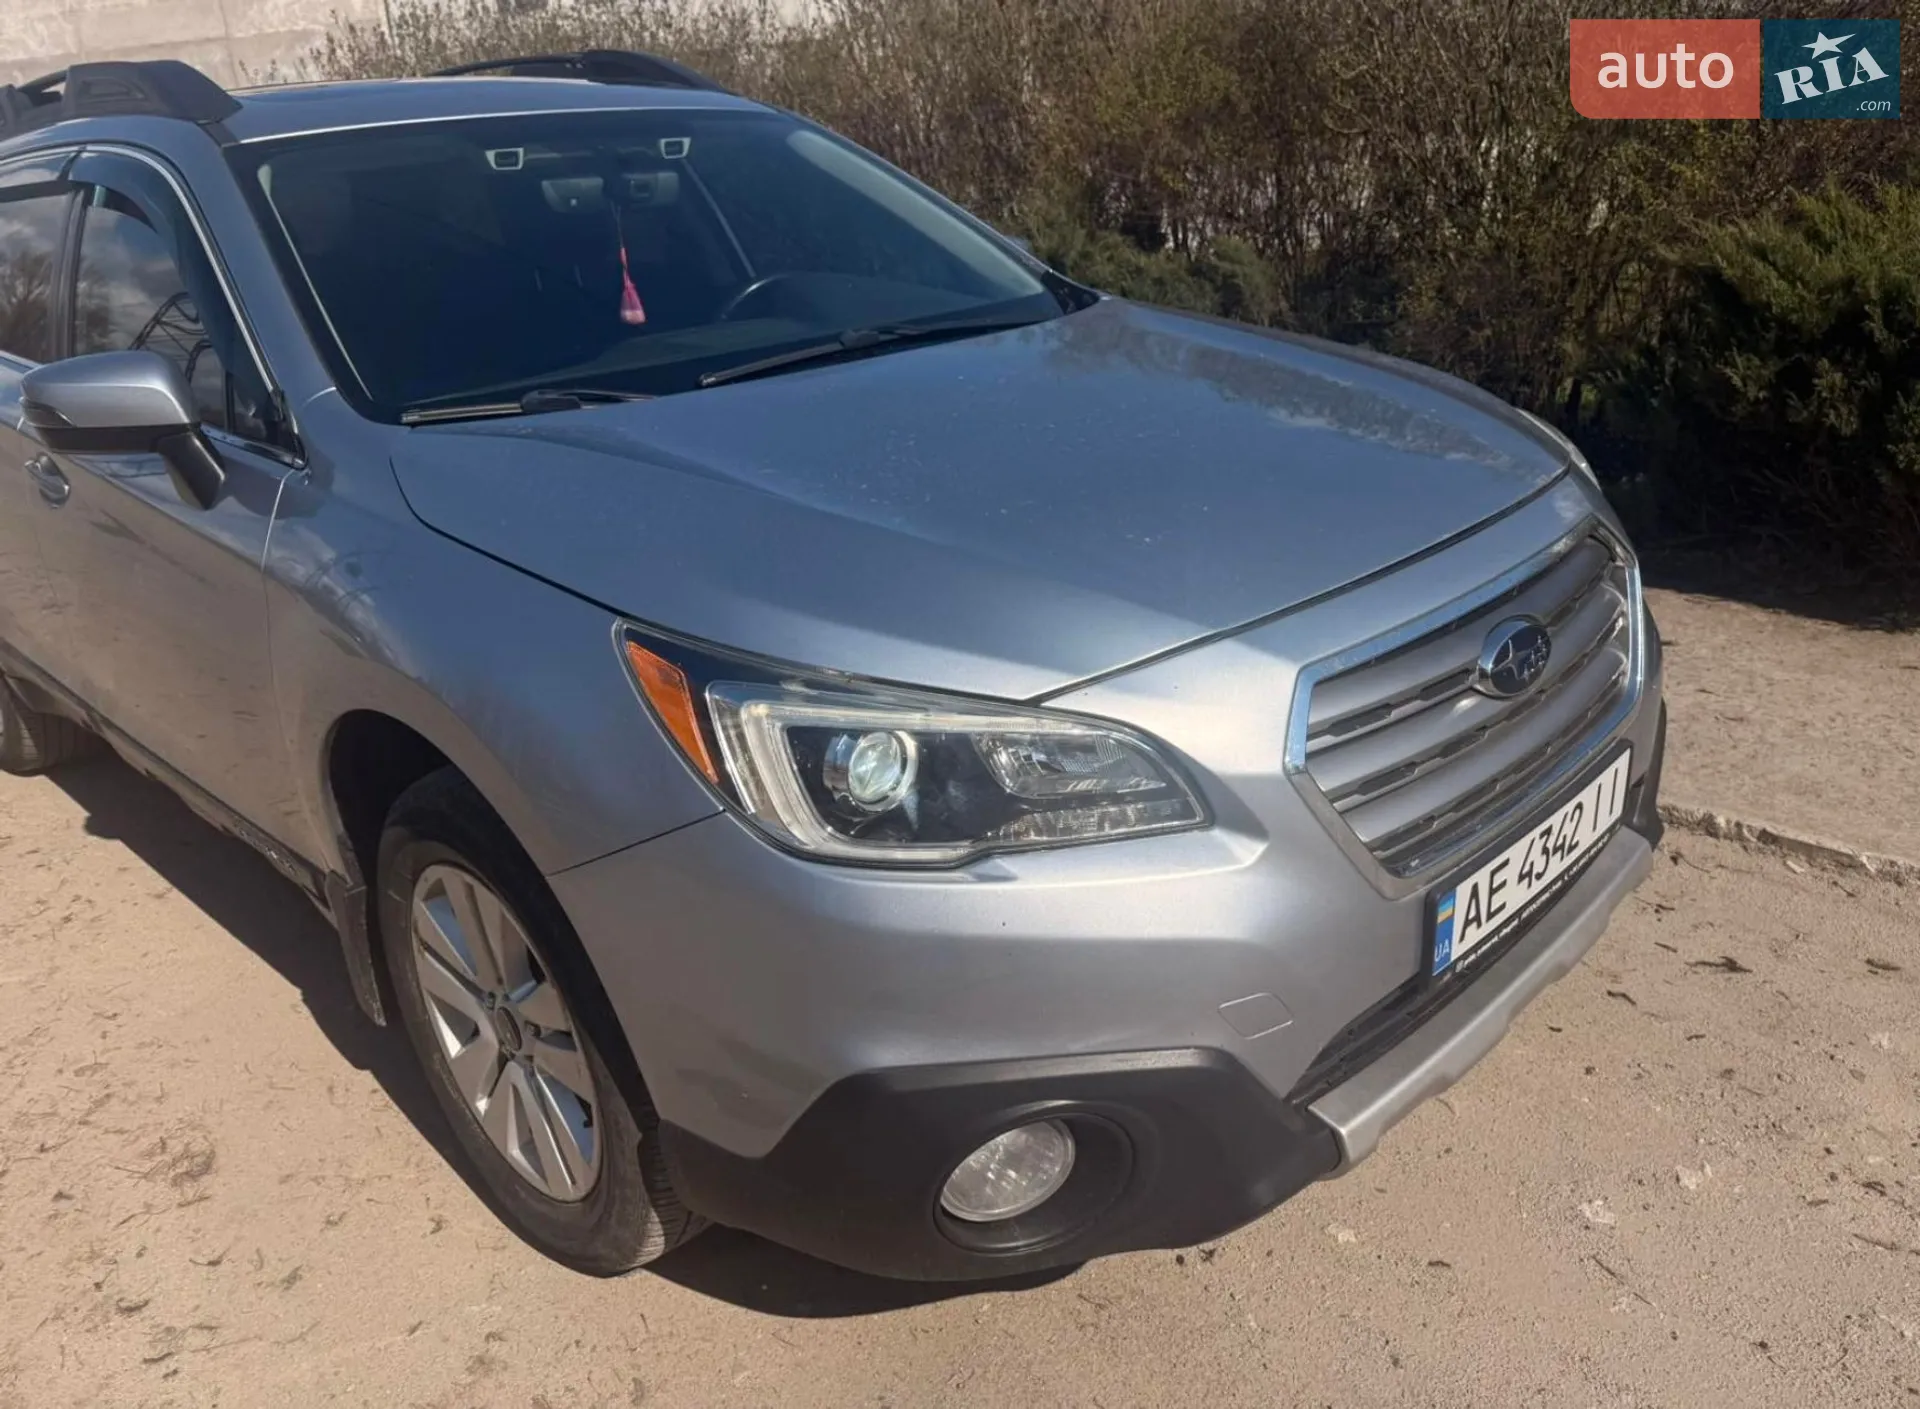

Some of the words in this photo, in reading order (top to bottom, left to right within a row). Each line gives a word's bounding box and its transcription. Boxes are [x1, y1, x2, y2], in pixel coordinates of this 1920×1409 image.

[1458, 857, 1510, 944] AE
[1517, 800, 1584, 890] 4342
[1592, 767, 1619, 832] II
[1434, 939, 1450, 962] UA
